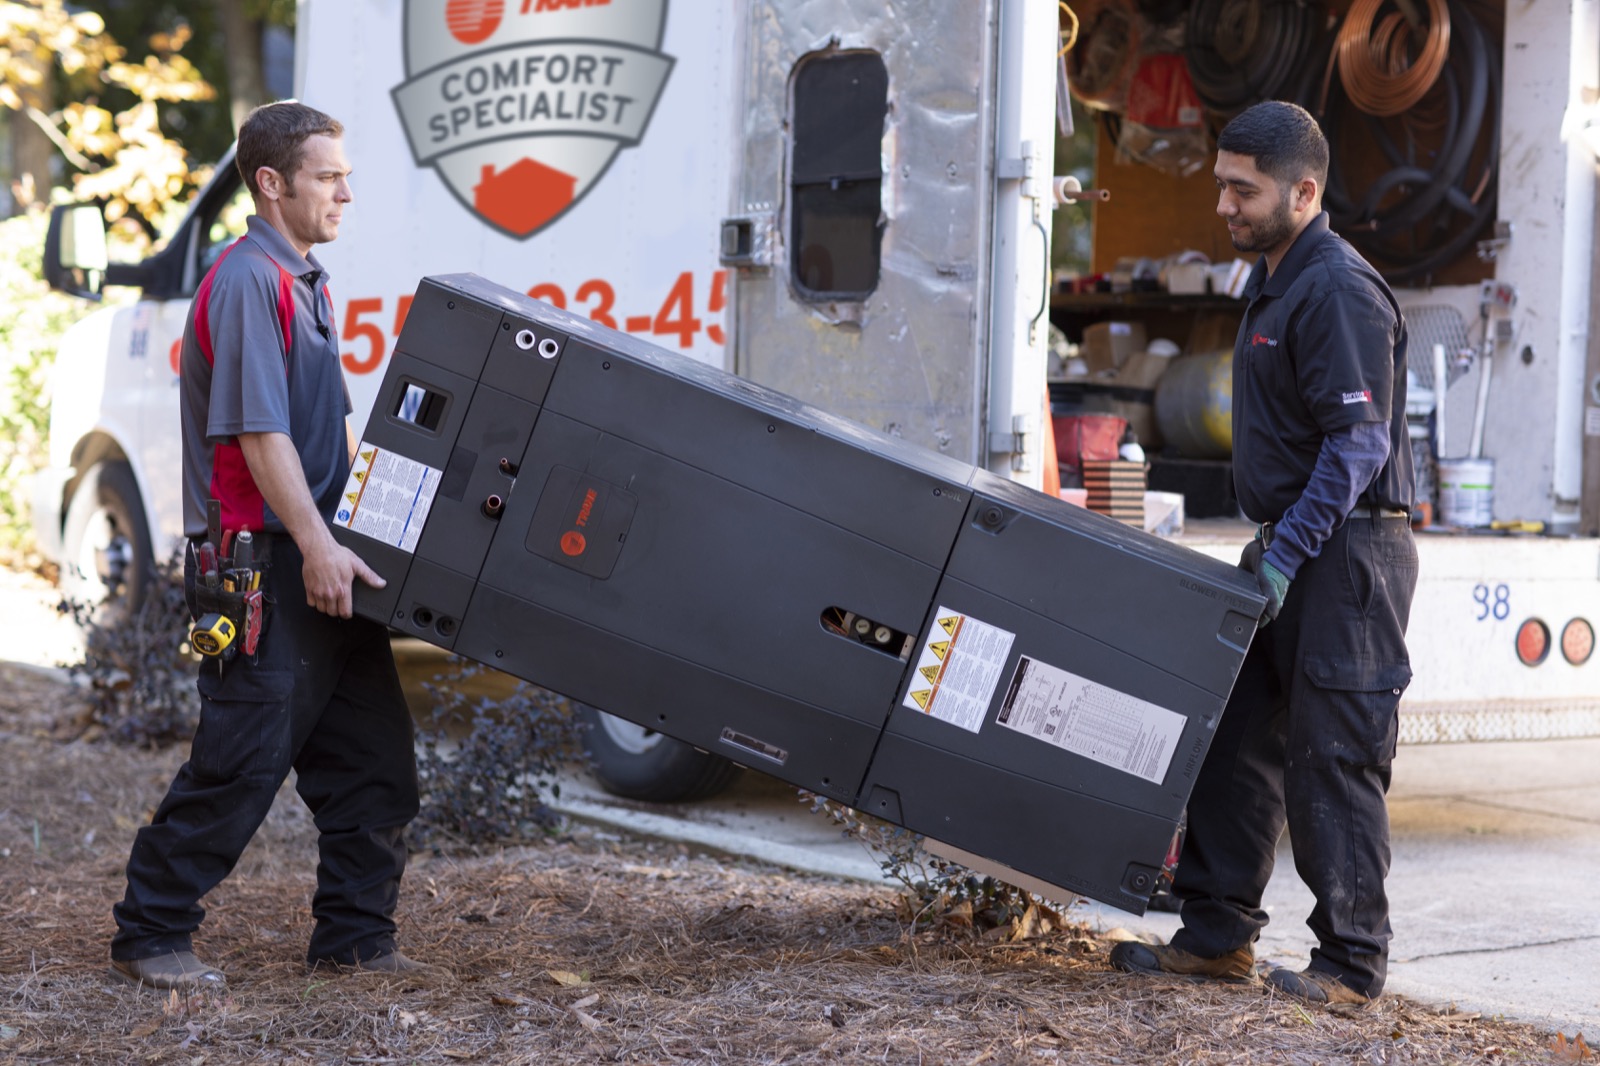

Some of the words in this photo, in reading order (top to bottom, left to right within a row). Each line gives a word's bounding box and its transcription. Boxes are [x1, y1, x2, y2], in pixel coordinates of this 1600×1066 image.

[520, 0, 613, 15] TRA
[440, 54, 624, 103] COMFORT
[428, 90, 635, 144] SPECIALIST
[576, 487, 597, 527] TRANE
[1179, 579, 1218, 600] BLOWER
[1223, 595, 1255, 613] FILTER
[1472, 583, 1511, 621] 98
[1183, 736, 1204, 779] AIRFLOW
